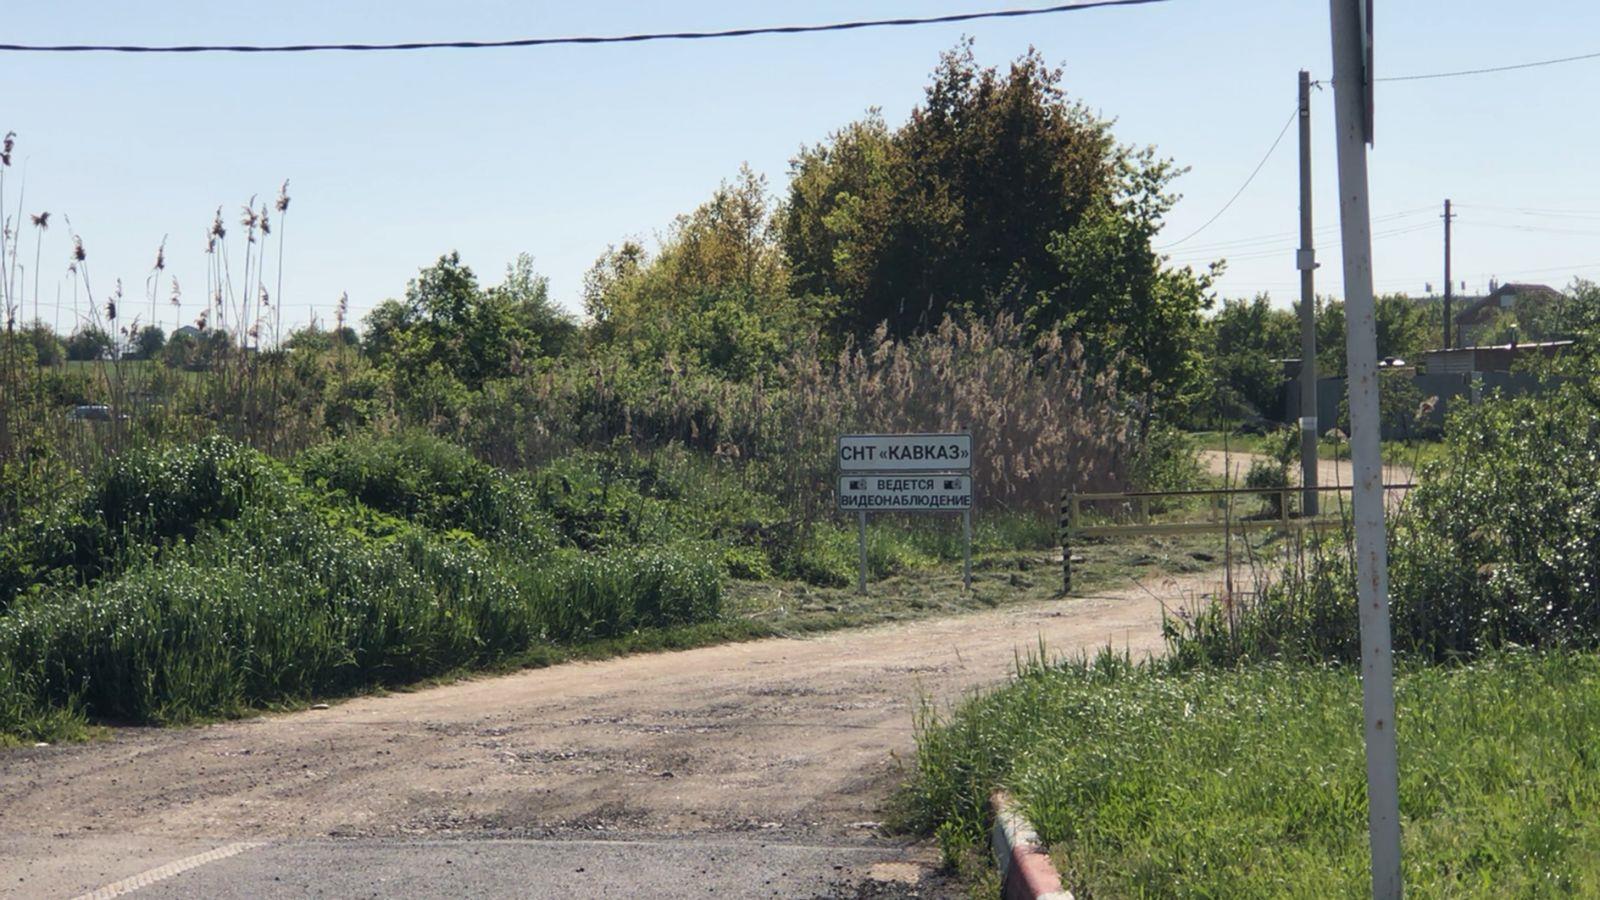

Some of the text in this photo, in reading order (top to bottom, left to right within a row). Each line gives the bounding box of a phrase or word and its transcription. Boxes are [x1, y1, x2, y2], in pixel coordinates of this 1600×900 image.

[841, 445, 969, 461] СНТ «КАВКАЗ»
[877, 479, 934, 491] ВЕДЕТСЯ
[841, 495, 971, 507] ВИДЕОНАБЛЮДЕНИЕ
